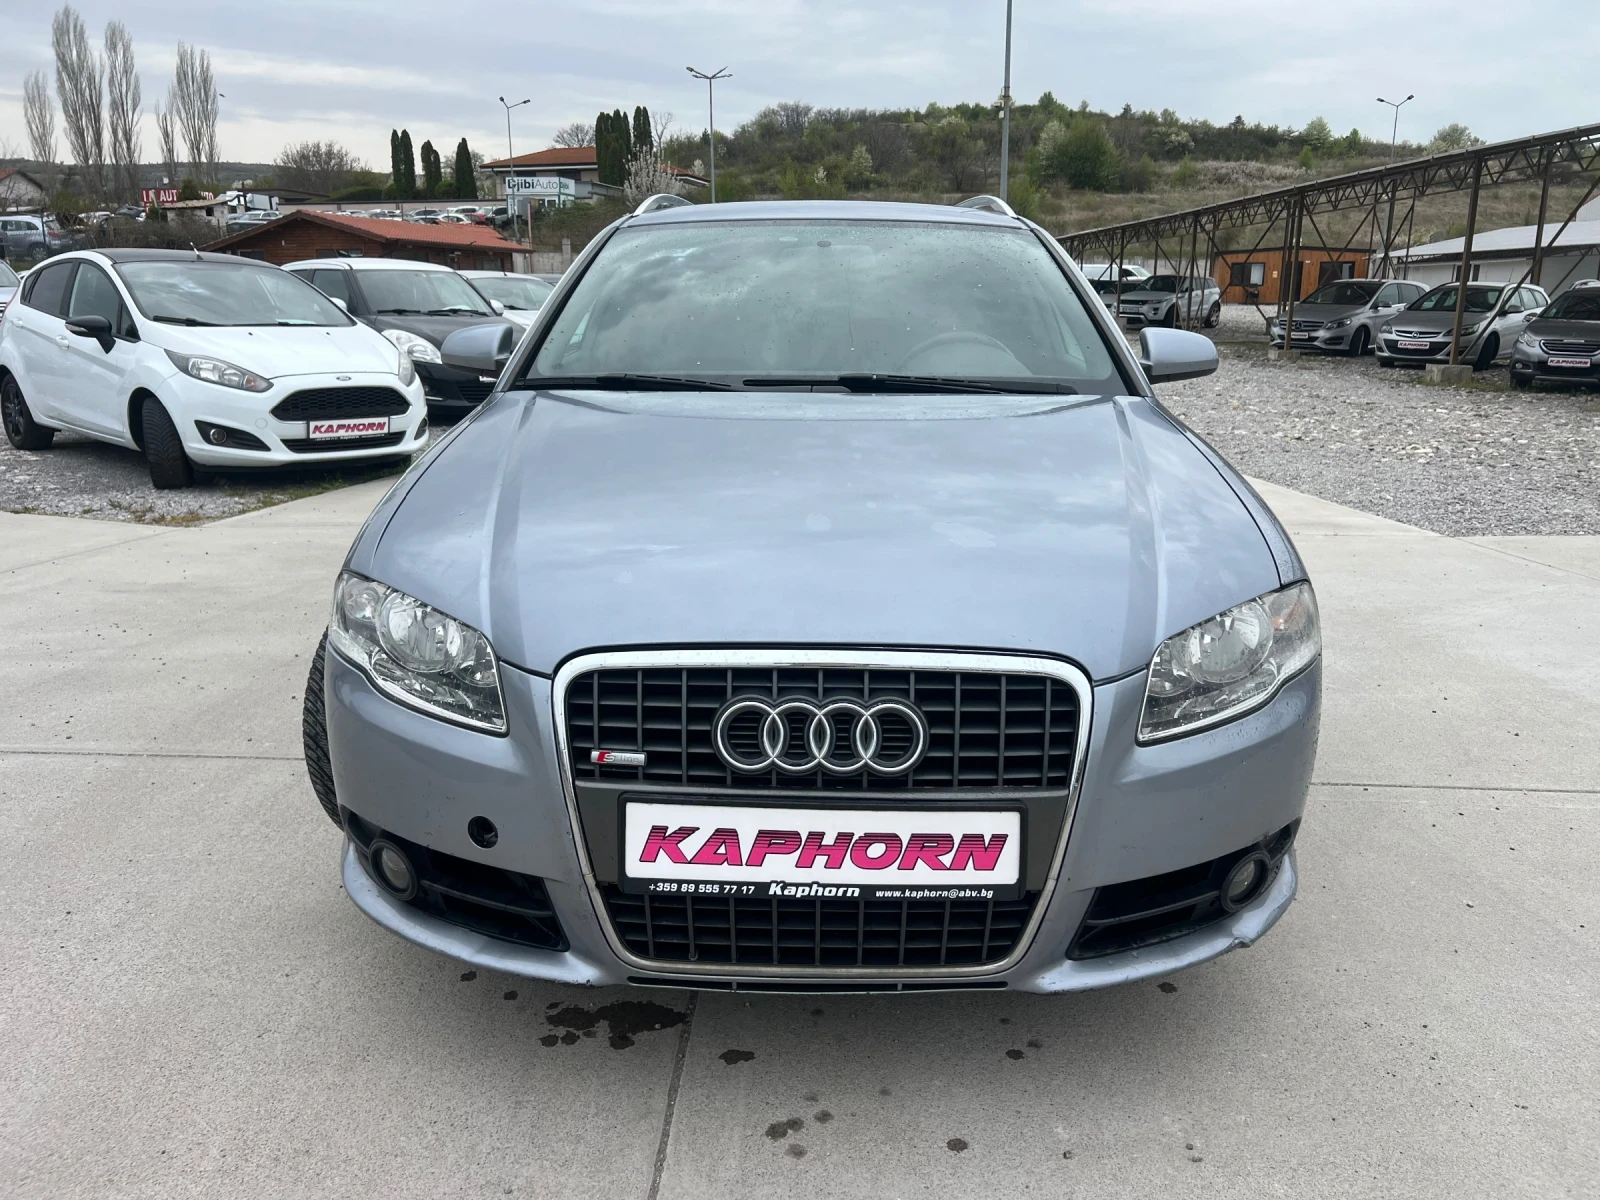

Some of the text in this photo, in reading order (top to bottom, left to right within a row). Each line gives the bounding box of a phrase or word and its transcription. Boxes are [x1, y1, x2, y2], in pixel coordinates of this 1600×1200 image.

[160, 189, 181, 201] AUT
[312, 422, 386, 434] KAPHORN
[639, 825, 1008, 871] KAPHORN
[649, 882, 755, 895] +359 89 555 77 17
[768, 882, 860, 898] Kaphorn
[875, 889, 994, 899] www.kaphorn@abv.bg
